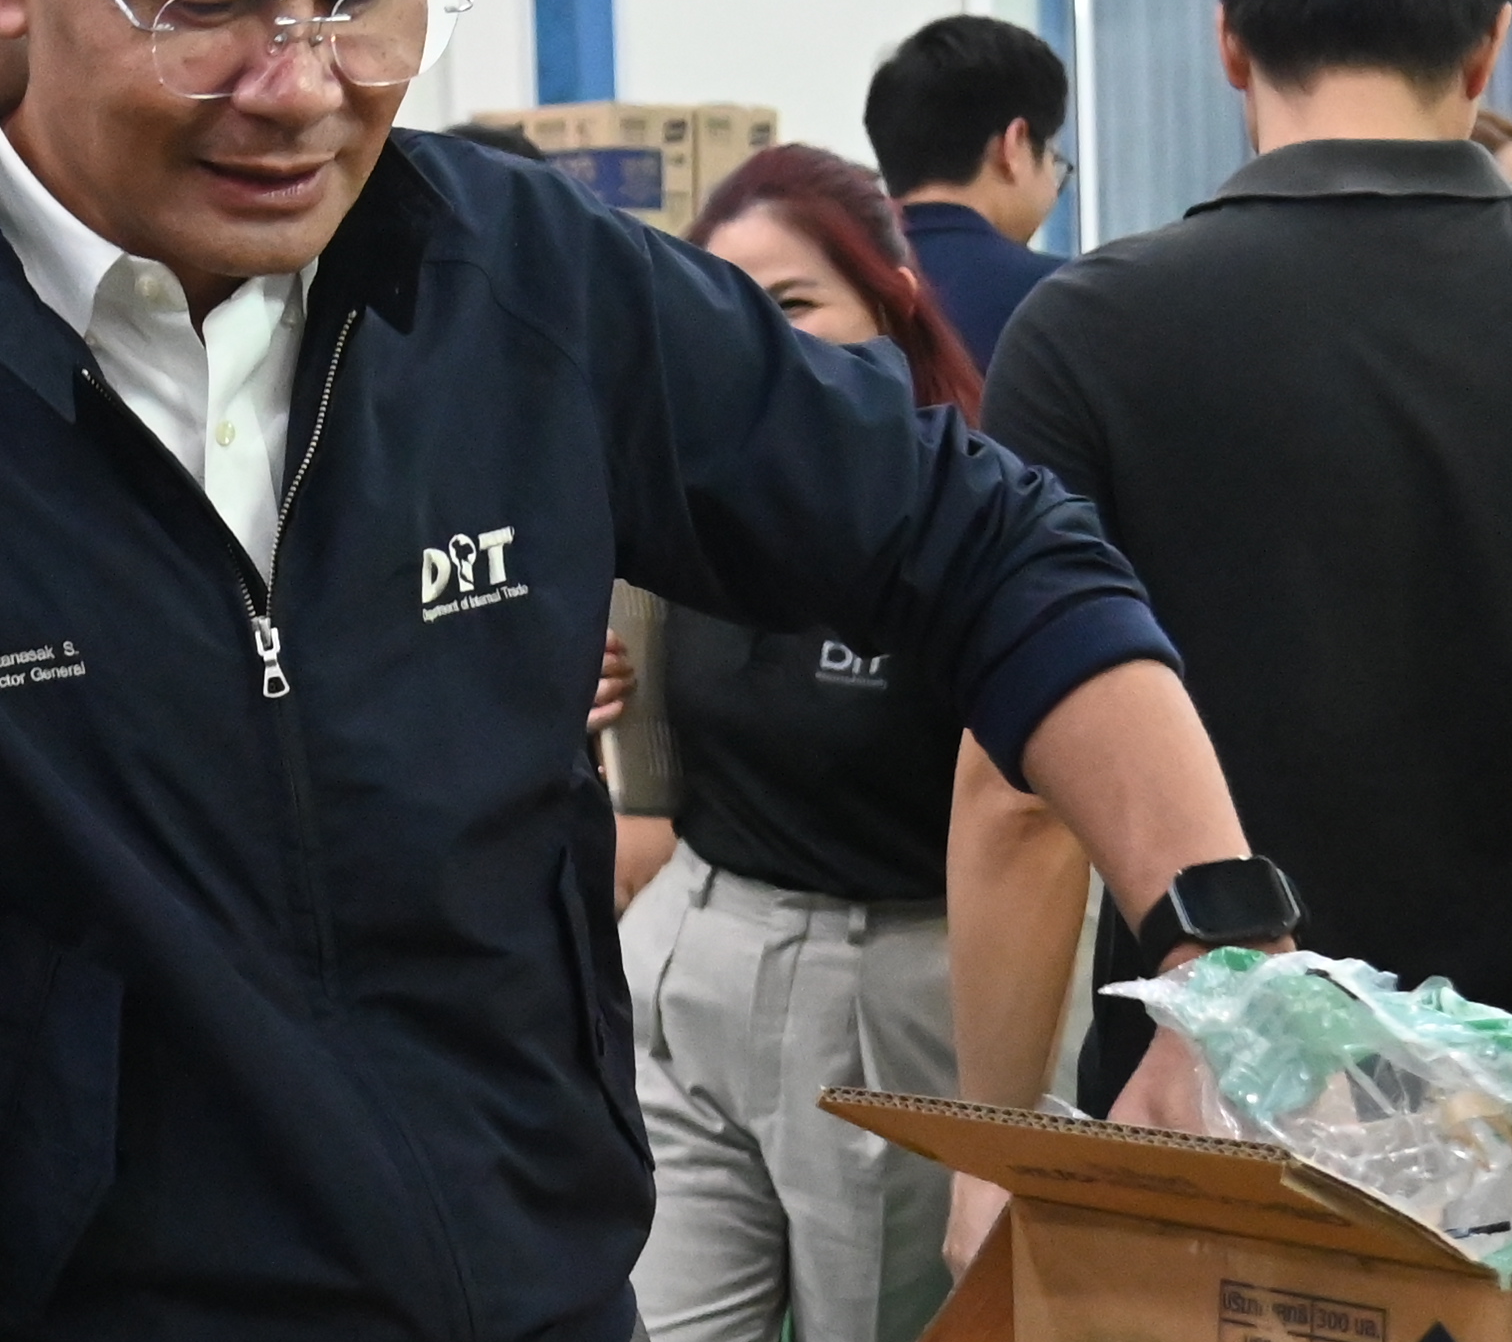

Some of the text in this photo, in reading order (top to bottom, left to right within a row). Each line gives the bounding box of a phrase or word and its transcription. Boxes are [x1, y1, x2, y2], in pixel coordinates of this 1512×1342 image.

[62, 640, 80, 656] S.
[30, 661, 86, 681] General
[1316, 1311, 1349, 1333] 300
